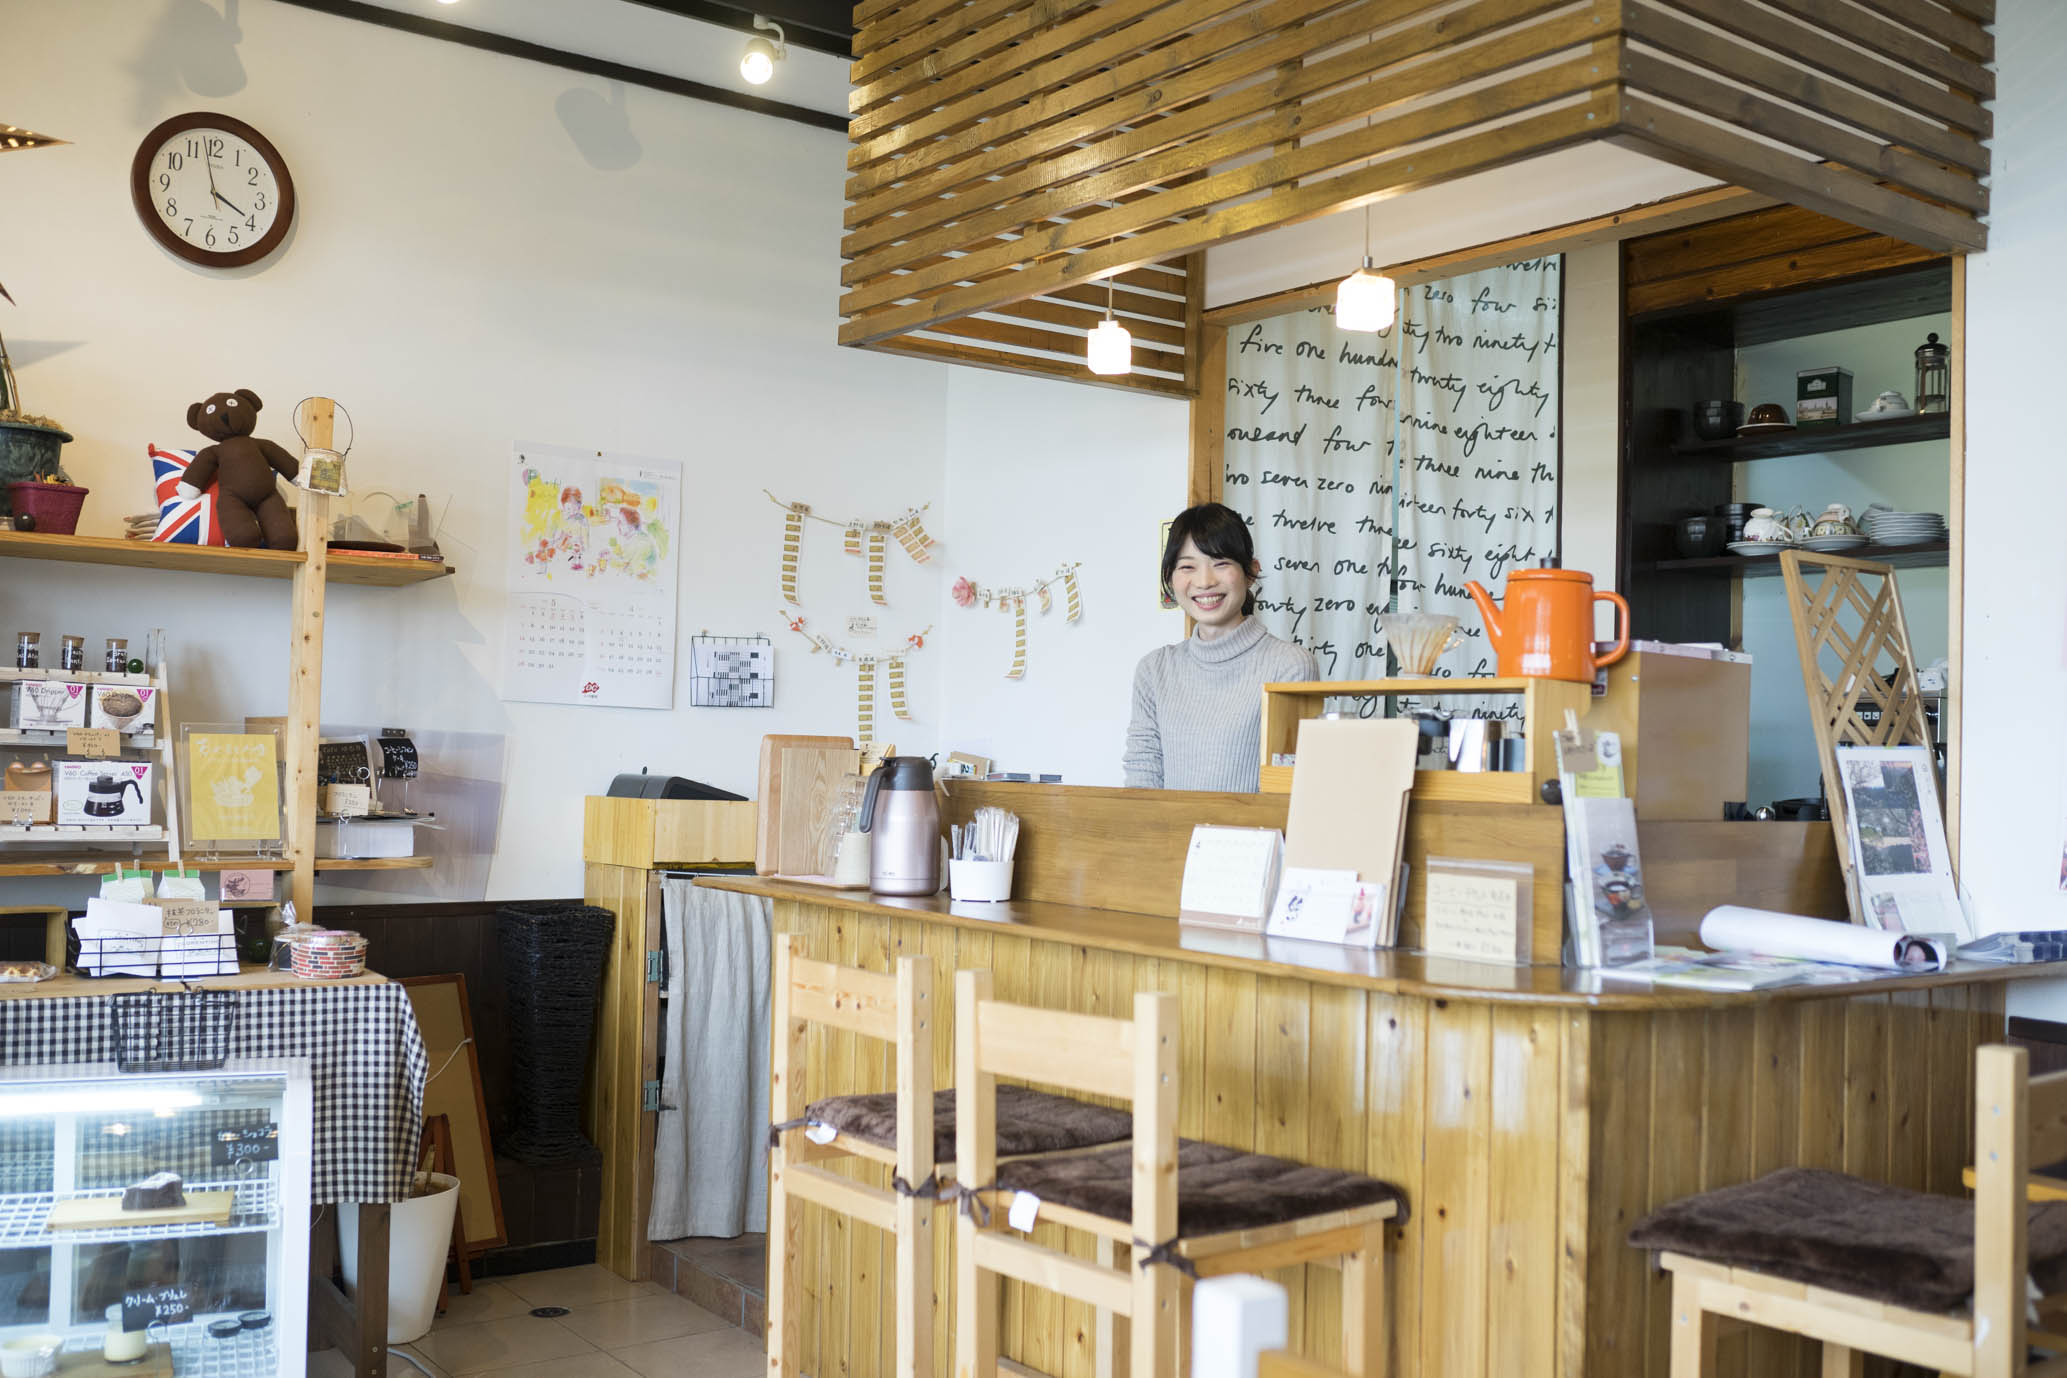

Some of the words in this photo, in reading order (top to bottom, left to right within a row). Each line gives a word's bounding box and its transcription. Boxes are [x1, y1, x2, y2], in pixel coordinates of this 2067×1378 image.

[187, 139, 199, 159] 11
[208, 139, 224, 158] 12
[168, 151, 183, 171] 10
[159, 173, 171, 192] 9
[247, 167, 259, 186] 2
[166, 198, 177, 217] 8
[254, 192, 266, 210] 3
[183, 218, 194, 237] 7
[244, 214, 256, 232] 4
[205, 227, 216, 246] 6
[227, 226, 239, 244] 5
[1424, 285, 1454, 303] zero
[1472, 286, 1517, 314] four
[1239, 323, 1284, 354] five
[1296, 341, 1327, 360] one
[1436, 325, 1463, 347] two
[1473, 329, 1540, 363] ninety
[1228, 377, 1280, 415] sixty
[1294, 384, 1340, 410] three
[1410, 366, 1467, 413] twenty
[1476, 375, 1550, 418] eighty
[1323, 424, 1372, 455] four
[1453, 415, 1538, 458] eighteen
[1414, 455, 1460, 478] three
[1474, 459, 1520, 481] nine
[1261, 470, 1308, 489] seven
[1318, 477, 1355, 494] zero
[1272, 508, 1337, 535] twelve
[1452, 497, 1496, 535] forty
[1504, 507, 1534, 524] six
[1274, 556, 1320, 574] seven
[1334, 559, 1369, 576] one
[1427, 542, 1473, 575] sixty
[1484, 543, 1536, 580] eight
[1314, 597, 1356, 612] zero
[1355, 641, 1385, 658] one
